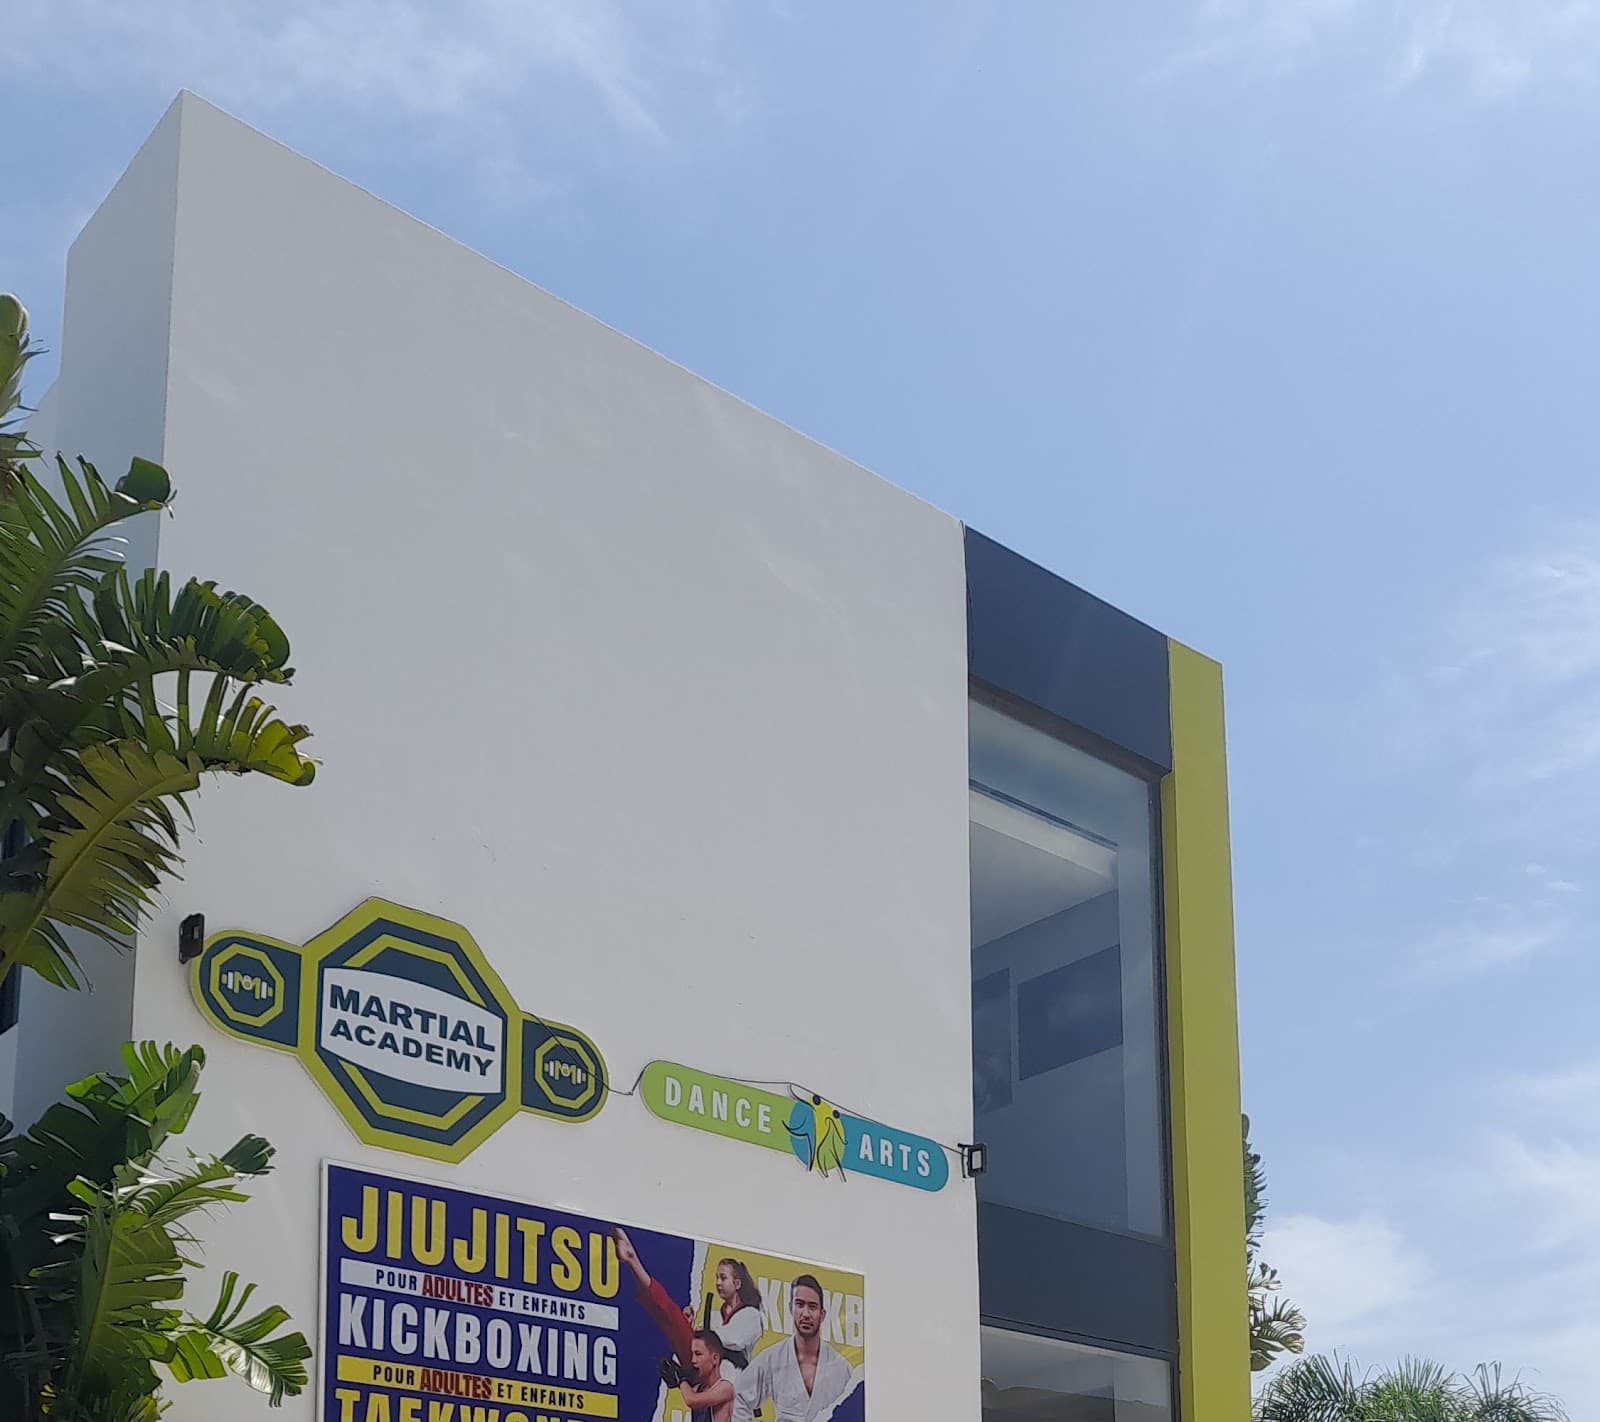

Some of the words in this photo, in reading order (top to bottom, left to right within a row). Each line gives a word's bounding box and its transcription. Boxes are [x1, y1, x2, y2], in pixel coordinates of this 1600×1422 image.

[329, 983, 496, 1053] MARTIAL
[330, 1018, 494, 1078] ACADEMY
[664, 1076, 772, 1134] DANCE
[859, 1133, 931, 1178] ARTS
[341, 1185, 621, 1298] JIUJITSU
[376, 1268, 417, 1291] POUR
[422, 1274, 494, 1307] ADULTES
[499, 1291, 515, 1308] ET
[522, 1293, 586, 1320] ENFANTS
[338, 1292, 618, 1385] KICKBOXING
[373, 1364, 415, 1386] POUR
[419, 1368, 493, 1400] ADULTES
[497, 1383, 513, 1398] ET
[521, 1386, 585, 1409] ENFANTS
